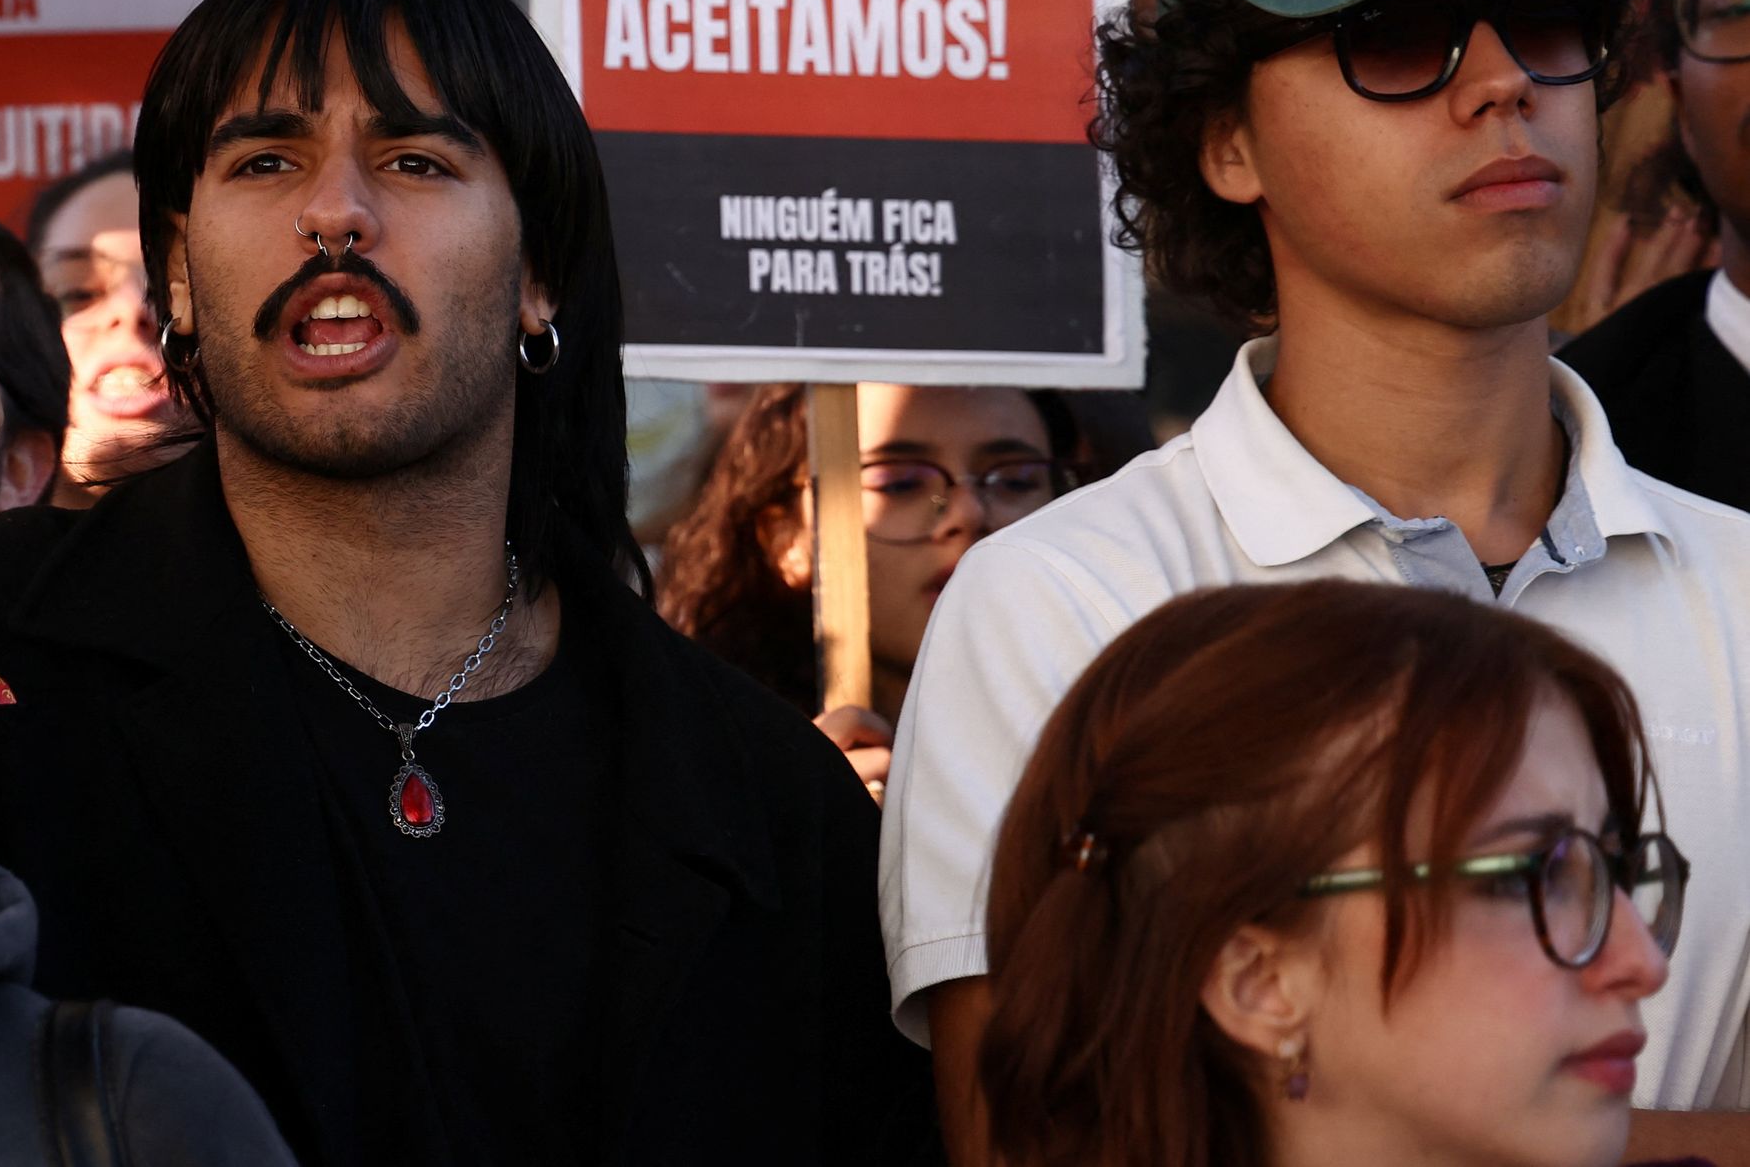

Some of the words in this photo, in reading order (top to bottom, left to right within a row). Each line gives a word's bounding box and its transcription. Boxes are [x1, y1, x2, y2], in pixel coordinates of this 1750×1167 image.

[719, 188, 873, 244] NINGUÉM
[882, 198, 957, 244] FICA
[749, 248, 838, 295] PARA
[847, 243, 942, 296] TRÁS!
